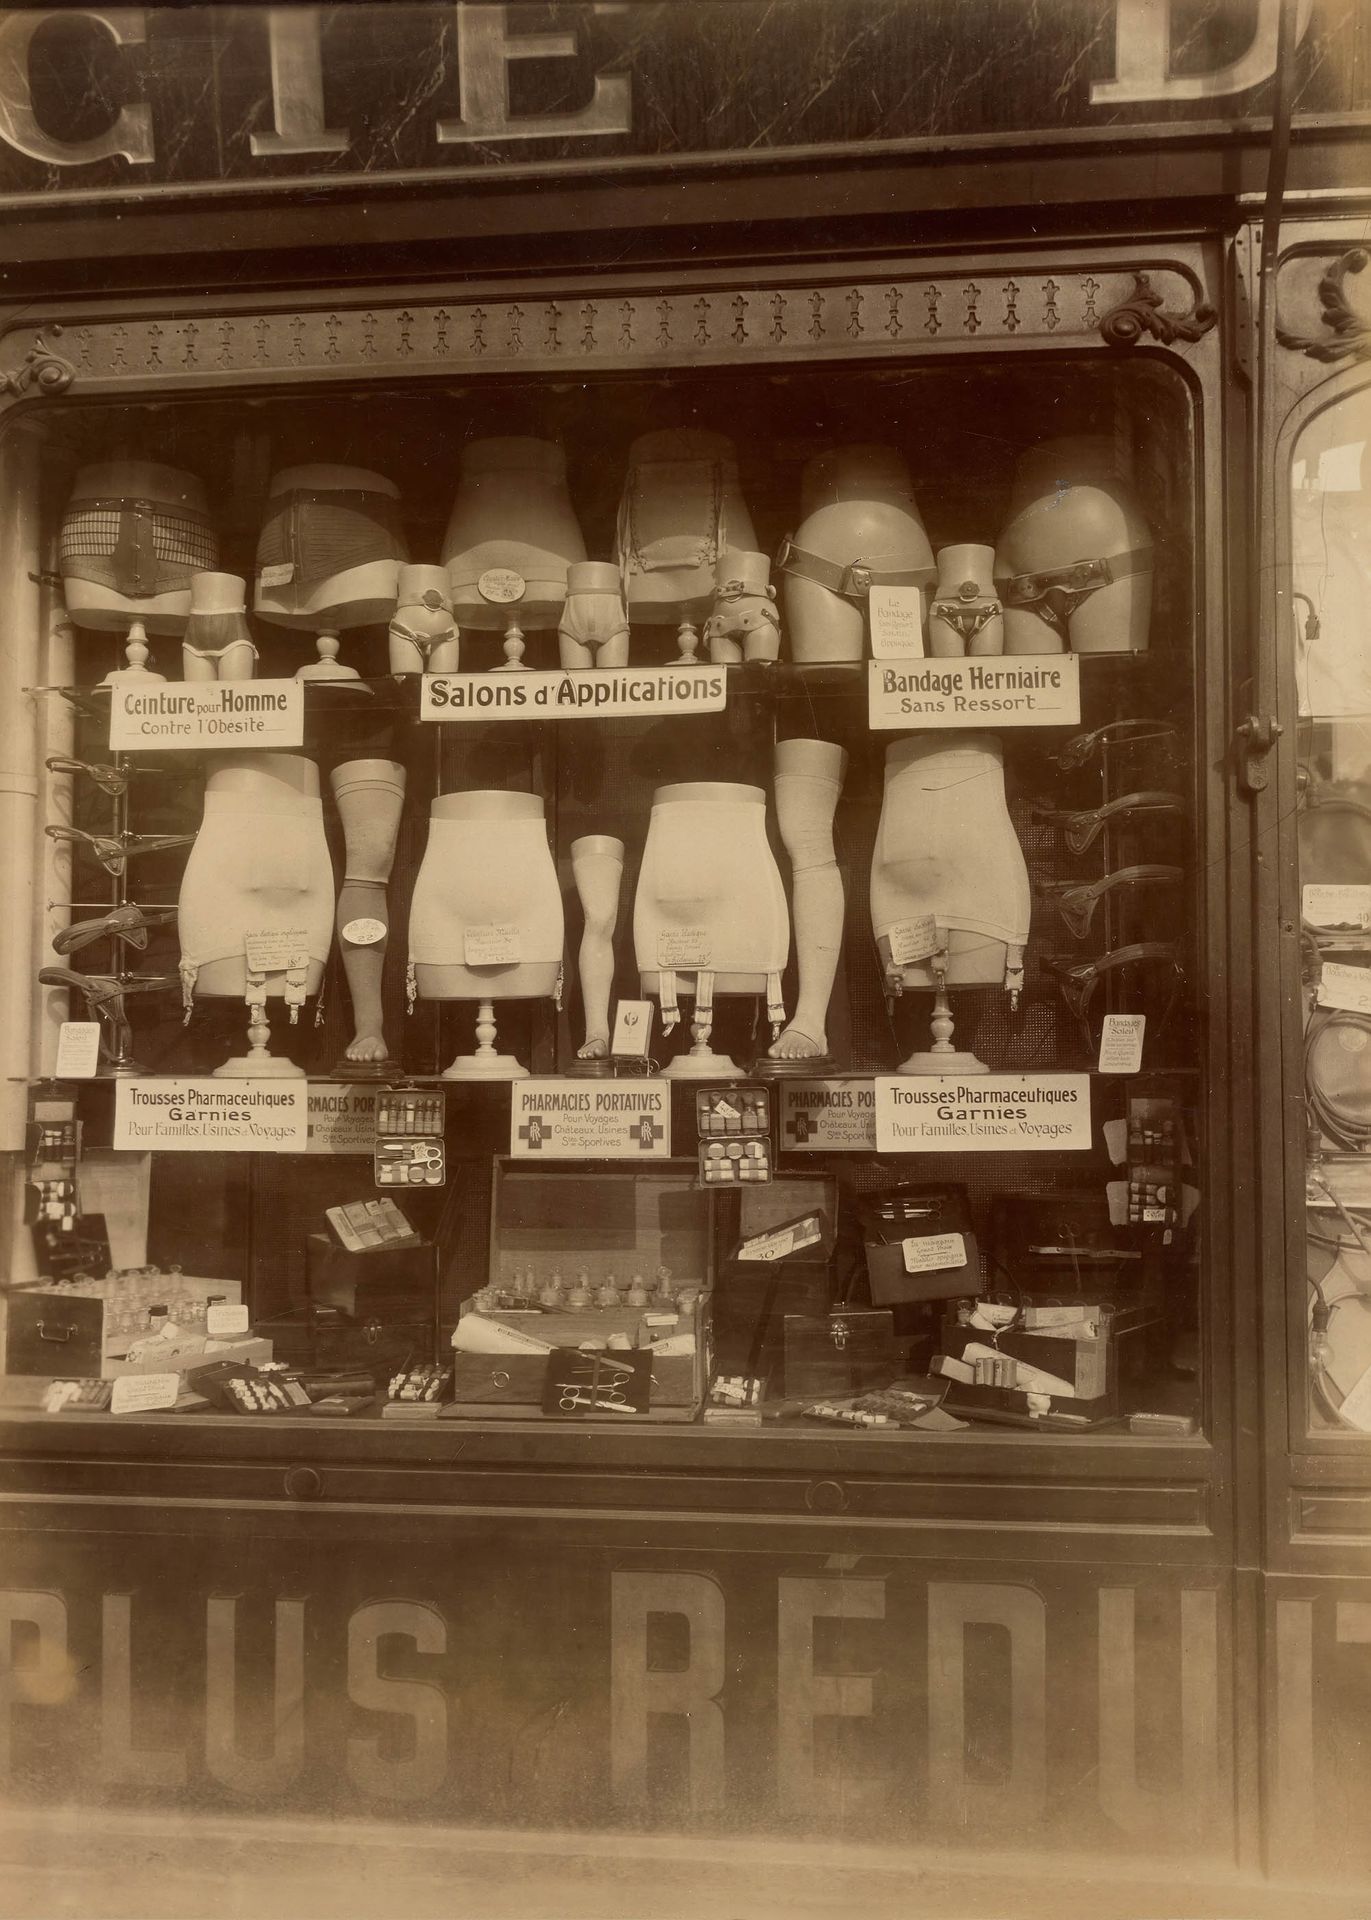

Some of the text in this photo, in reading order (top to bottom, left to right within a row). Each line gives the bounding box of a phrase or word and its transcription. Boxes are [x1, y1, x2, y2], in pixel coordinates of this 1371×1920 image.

[883, 666, 1061, 696] Bandage Herniaire
[430, 676, 723, 708] Salons d'Applications
[124, 689, 288, 717] Ceinture pour Homme
[901, 694, 1036, 714] Sans Ressort
[141, 720, 192, 735] Contre
[129, 1088, 295, 1109] Trousses Pharmaceutiques
[522, 1093, 662, 1112] PHARMACIES PORTATIVES
[788, 1091, 853, 1108] PHARMACIES
[890, 1086, 1078, 1105] Trousses Pharmaceutiques
[168, 1107, 252, 1121] Garnies
[562, 1113, 620, 1126] Pour Voyages
[827, 1109, 846, 1119] Pour
[937, 1105, 1028, 1121] Garnies
[128, 1121, 153, 1136] Pour
[202, 1122, 241, 1137] Usines
[249, 1123, 296, 1141] Voyages
[598, 1124, 628, 1135] Usines
[892, 1122, 919, 1137] Pour
[970, 1122, 1008, 1136] Usines
[1018, 1121, 1073, 1139] Voyages
[578, 1136, 622, 1149] Sportives
[0, 1588, 448, 1806] PLUS
